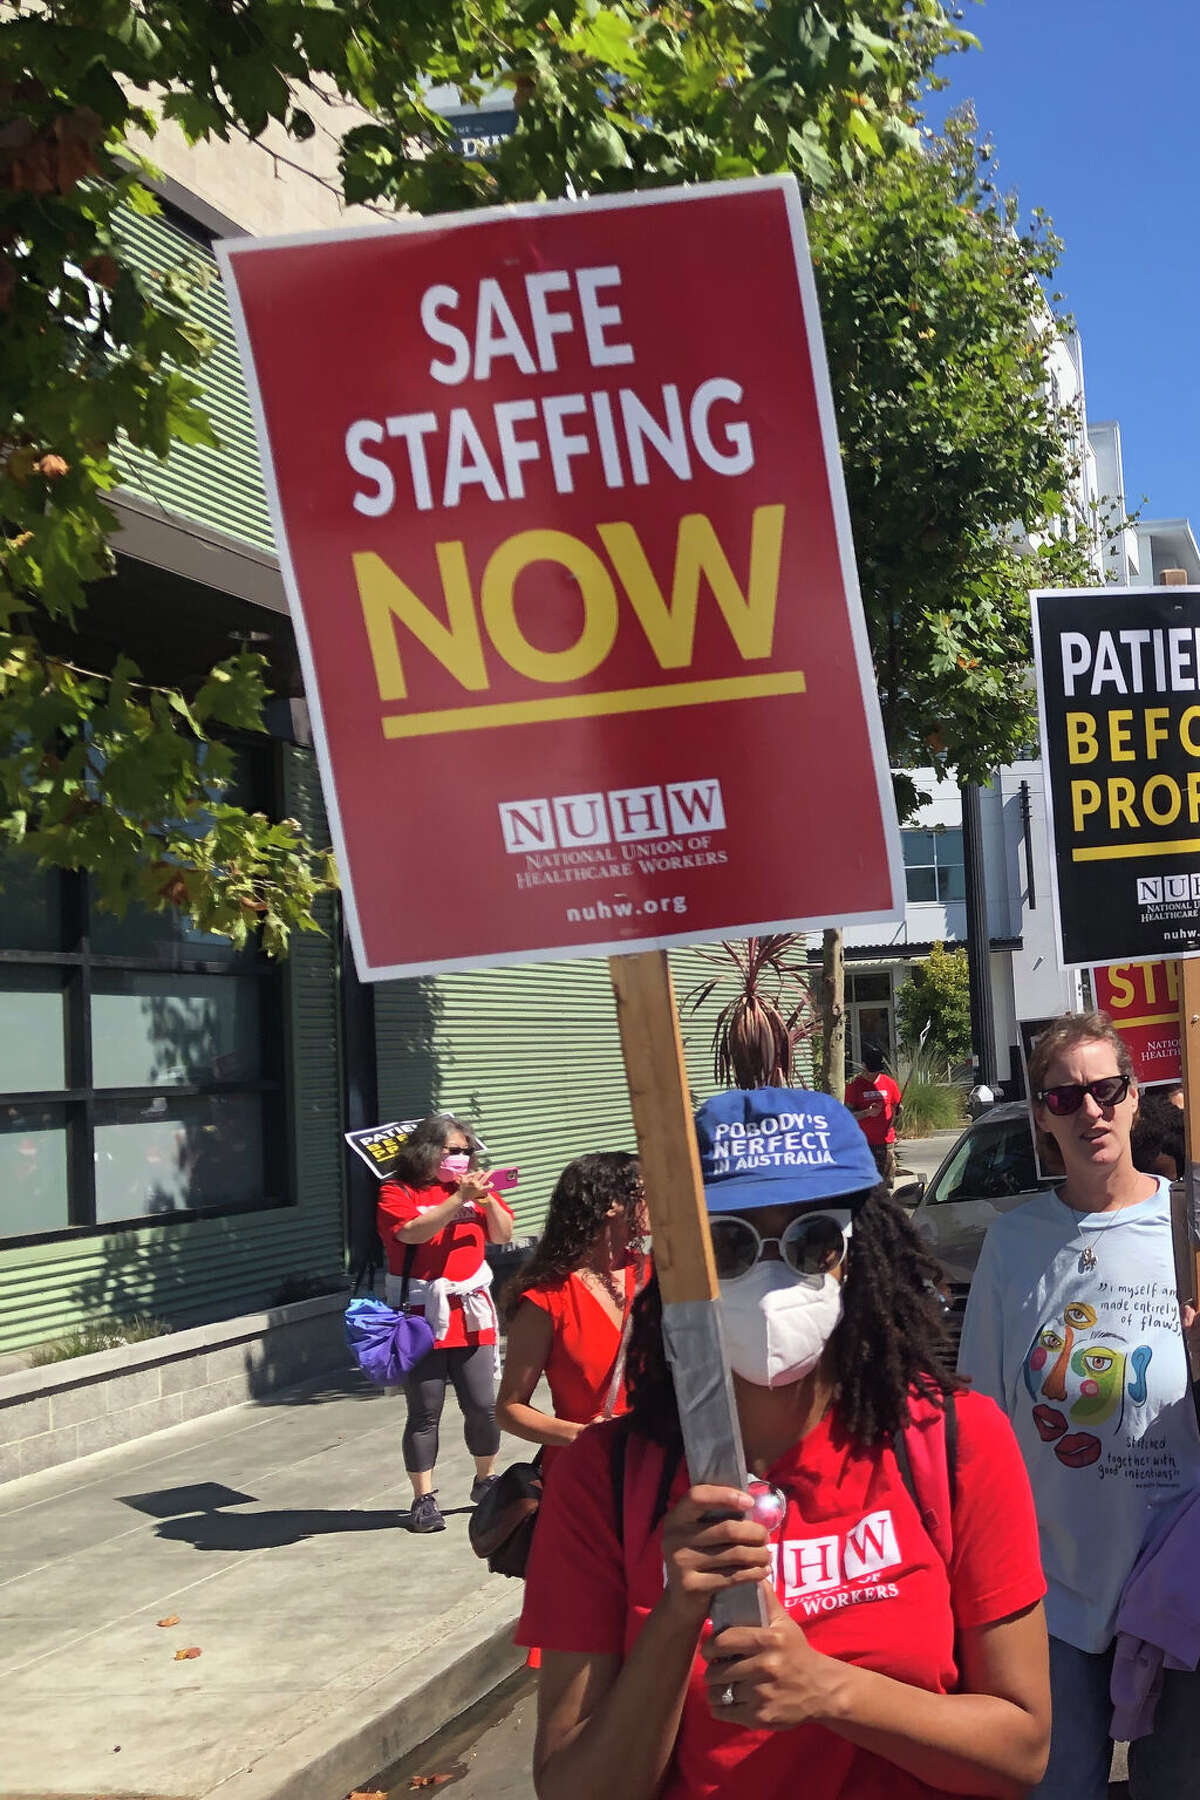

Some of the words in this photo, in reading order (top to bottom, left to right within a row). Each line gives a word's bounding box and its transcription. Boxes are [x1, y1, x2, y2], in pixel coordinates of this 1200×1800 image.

[420, 265, 634, 385] SAFE
[345, 377, 754, 517] STAFFING
[352, 504, 786, 701] NOW
[502, 782, 723, 850] NUHW
[525, 848, 615, 871] NATIONAL
[620, 839, 685, 860] UNION
[687, 836, 712, 851] OF
[516, 862, 634, 889] HEALTHCARE
[638, 850, 729, 875] WORKERS
[566, 895, 688, 923] nuhw.org
[1141, 911, 1199, 923] HEALTHCARE
[1147, 901, 1192, 914] NATIONAL
[1147, 1038, 1181, 1050] NATIO
[714, 1112, 828, 1141] POBODY'S
[712, 1131, 831, 1160] NERFECT
[713, 1160, 730, 1175] IN
[735, 1150, 838, 1171] AUSTRALIA
[1118, 1282, 1157, 1298] myself
[1100, 1299, 1129, 1311] made
[1133, 1301, 1177, 1321] entirely
[1120, 1313, 1132, 1326] of
[803, 1583, 899, 1616] WORKERS
